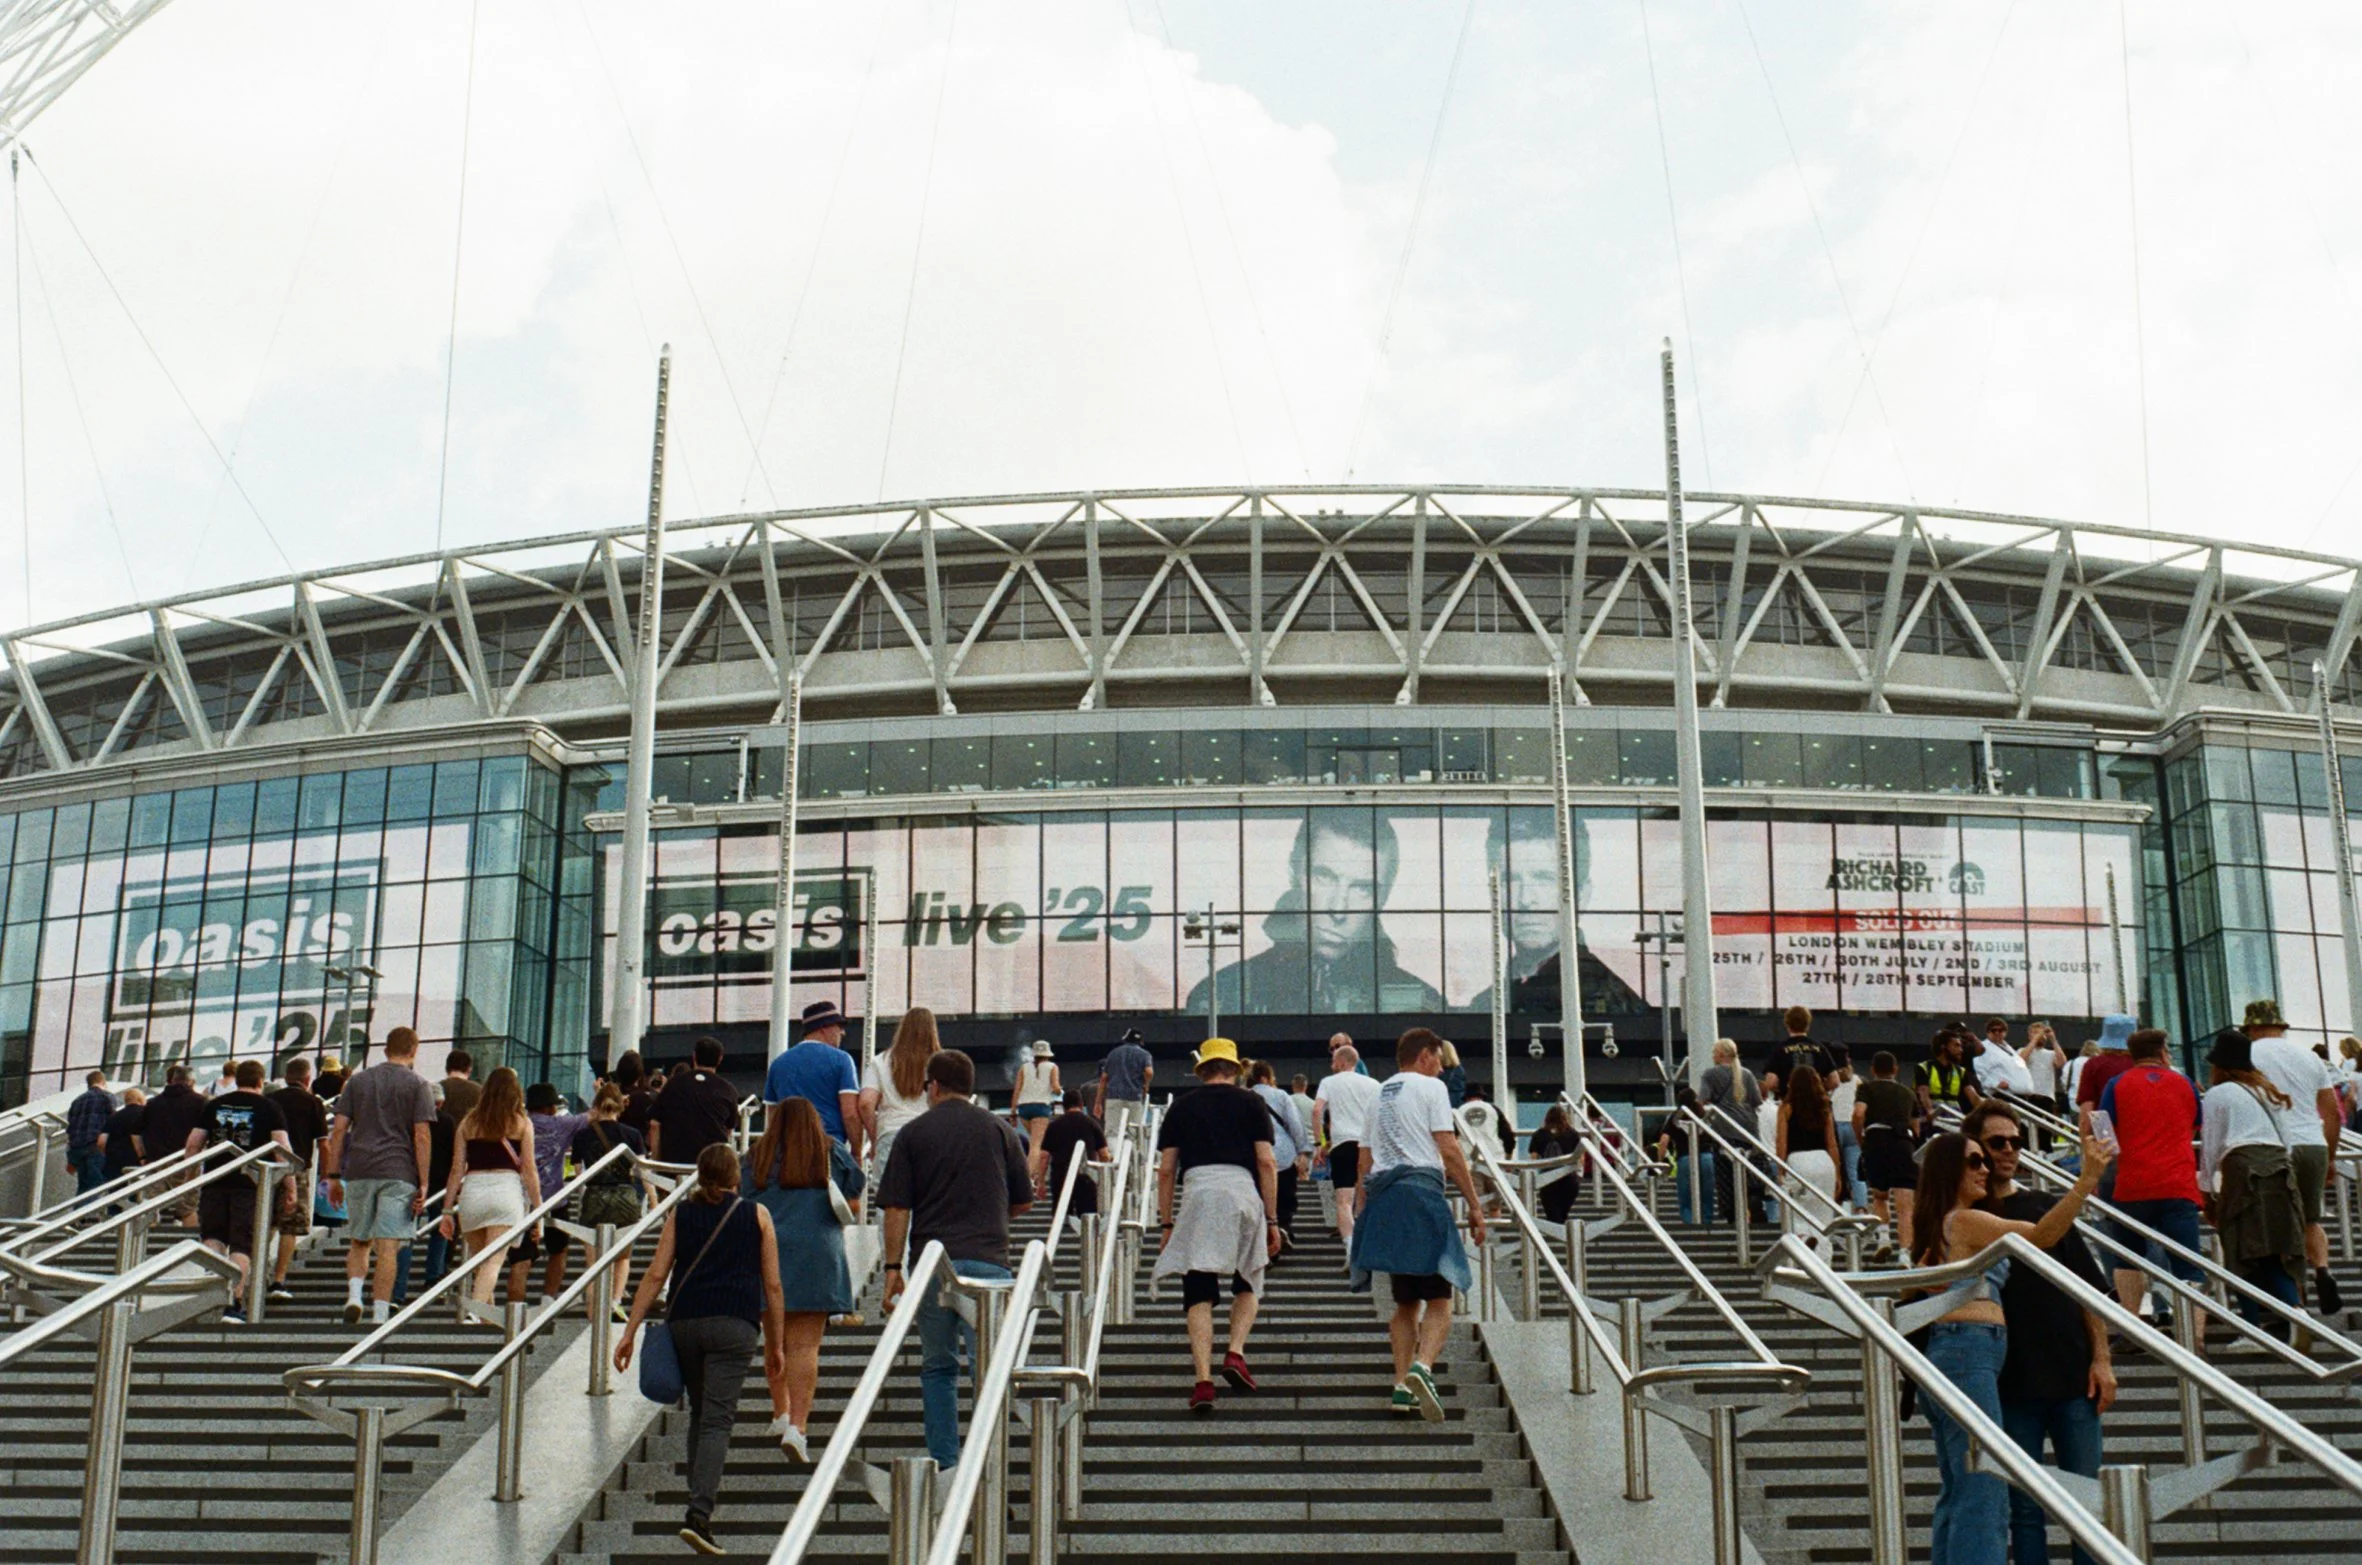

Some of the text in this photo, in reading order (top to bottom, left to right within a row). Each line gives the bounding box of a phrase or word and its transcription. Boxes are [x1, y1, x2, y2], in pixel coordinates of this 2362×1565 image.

[1834, 859, 1927, 876] RICHARD
[1826, 874, 1934, 893] ASHCROFT
[1949, 881, 1985, 895] CAST
[659, 894, 848, 956] oasis
[902, 891, 1026, 945] live
[1855, 910, 1958, 931] SOLD OUT
[136, 899, 353, 977] oasis
[1789, 936, 2026, 954] LONDON WEMBLEY STADIUM
[1713, 951, 1752, 964] 25TH
[1775, 952, 1816, 966] 26TH
[1836, 954, 1880, 968] 30TH
[1885, 956, 1928, 969] JULY
[1945, 957, 1981, 970] 2ND
[1997, 959, 2032, 972] 3RD
[2038, 960, 2103, 974] AUGUST
[1802, 972, 1847, 985] 27TH
[1865, 973, 1911, 986] 28TH
[1916, 974, 2016, 989] SEPTEMBER
[103, 1027, 229, 1087] live
